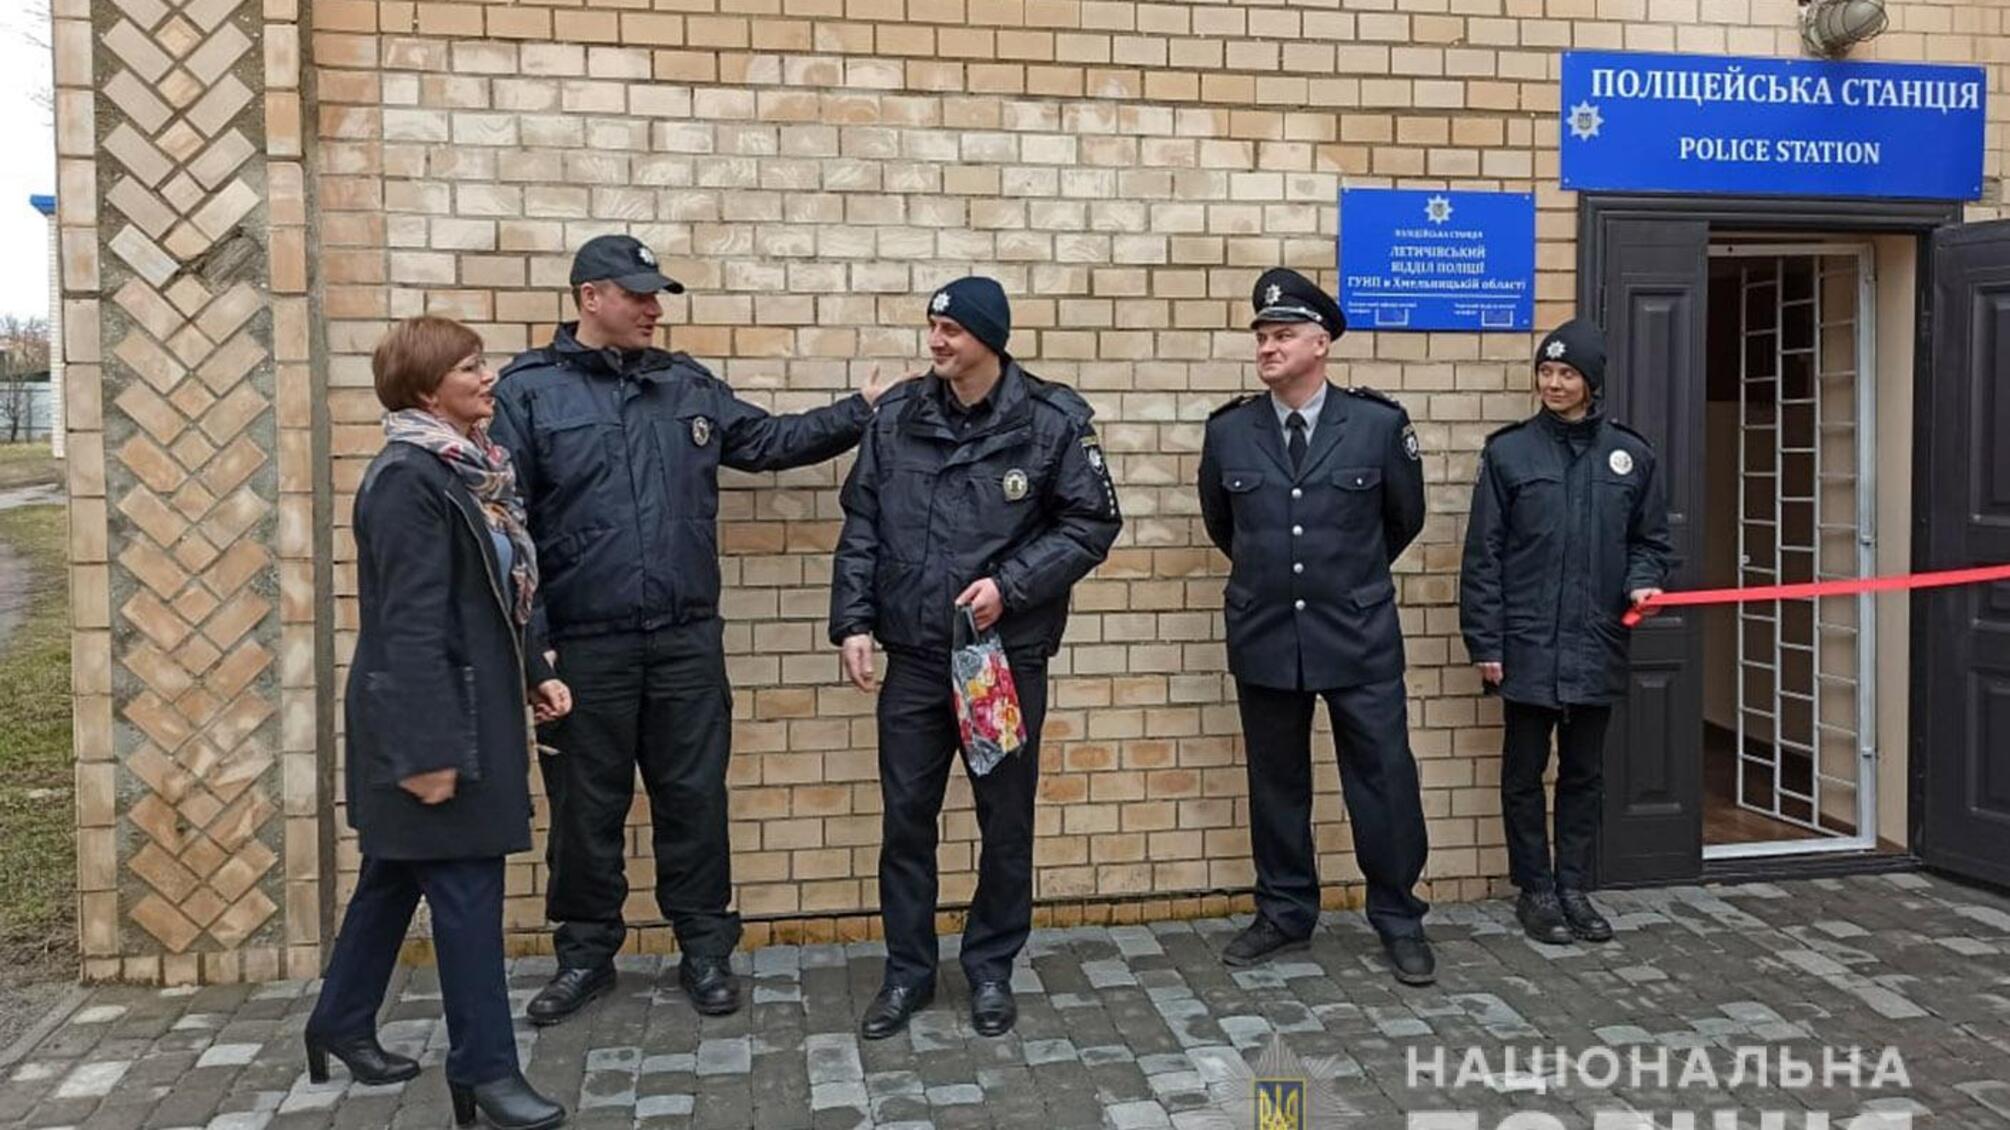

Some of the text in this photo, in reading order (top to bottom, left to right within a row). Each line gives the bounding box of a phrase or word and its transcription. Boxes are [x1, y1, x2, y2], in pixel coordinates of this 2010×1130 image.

[1591, 66, 1980, 114] ПОЛІЦЕЙСЬКА СТАНЦІЯ
[1679, 137, 1881, 165] POLICE STATION
[1391, 244, 1485, 258] ЛЕТИЧІВСЬКИЙ
[1391, 261, 1485, 275] ВІДДІЛ ПОЛІЦІЇ
[1347, 276, 1381, 288] ГУНП
[1392, 277, 1479, 291] Хмельницькій
[1481, 278, 1527, 290] області
